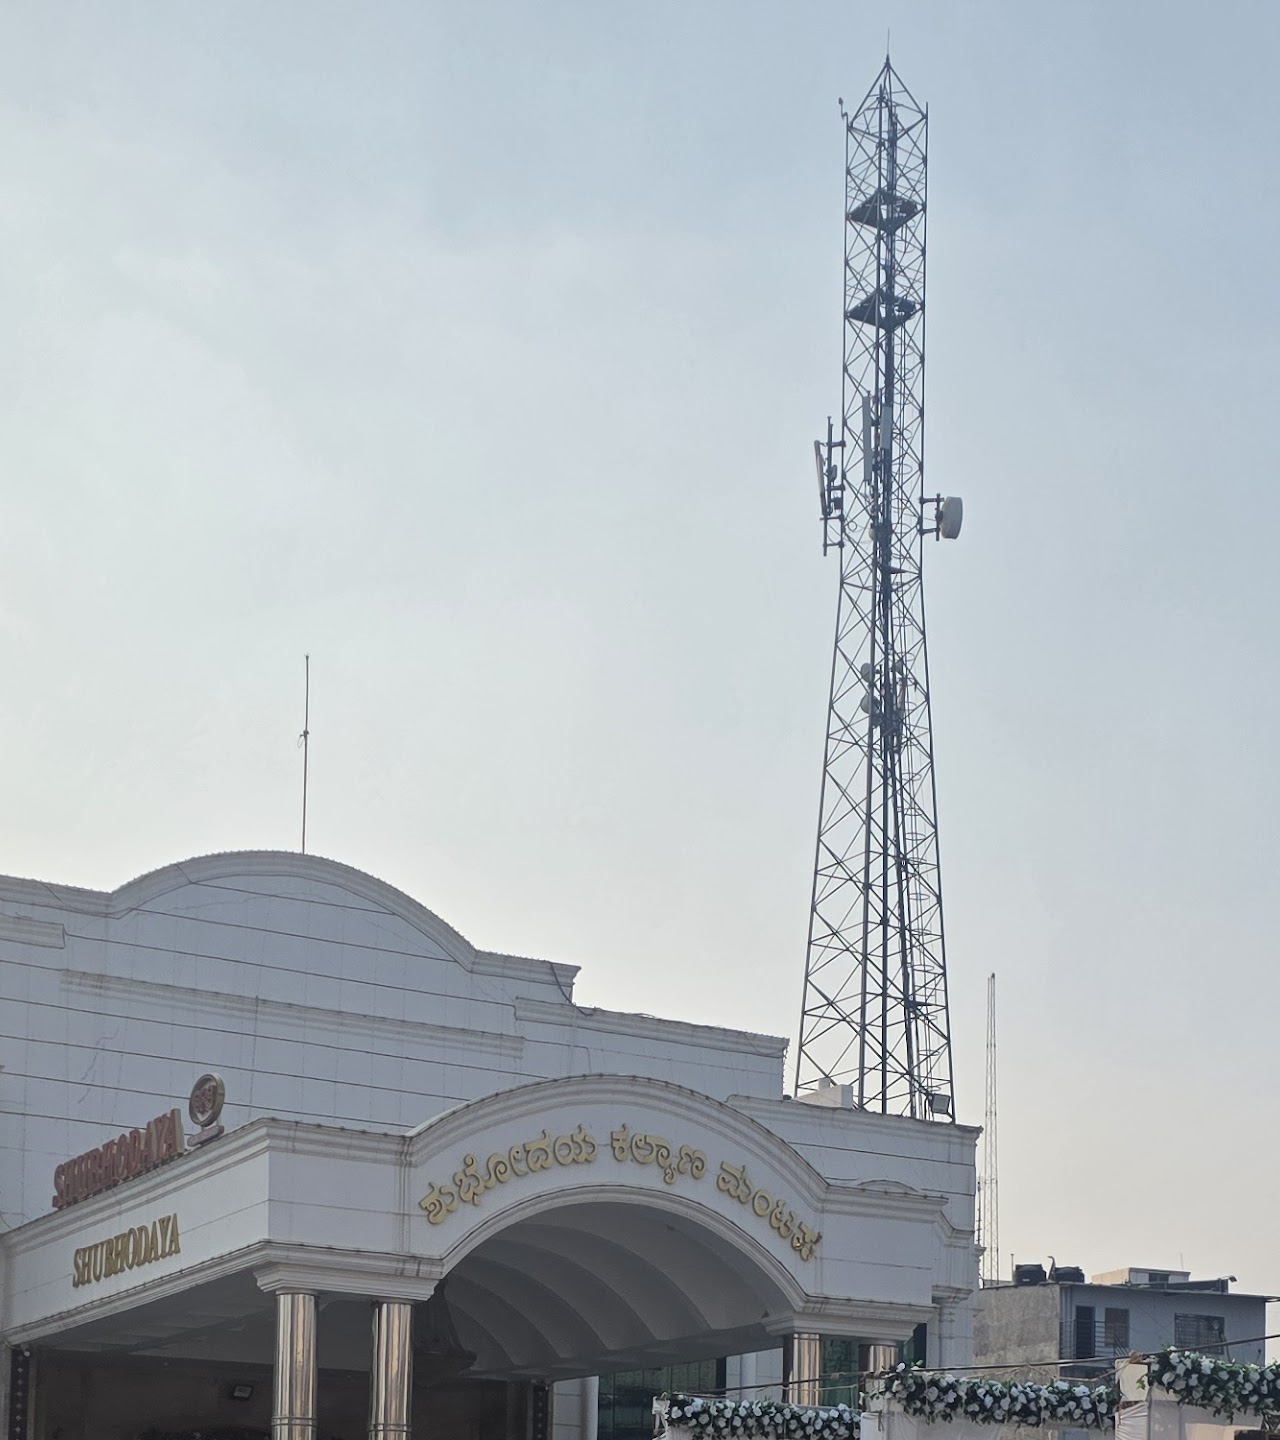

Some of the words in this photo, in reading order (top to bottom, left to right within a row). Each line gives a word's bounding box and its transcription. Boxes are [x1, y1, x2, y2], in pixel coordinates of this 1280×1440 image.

[419, 1123, 598, 1226] ಶುಭೋದಯ
[610, 1122, 706, 1185] ಕಲ್ಯಾಣ
[716, 1160, 821, 1262] ಮಂಟಪ
[73, 1212, 181, 1288] SHUBHODAYA
